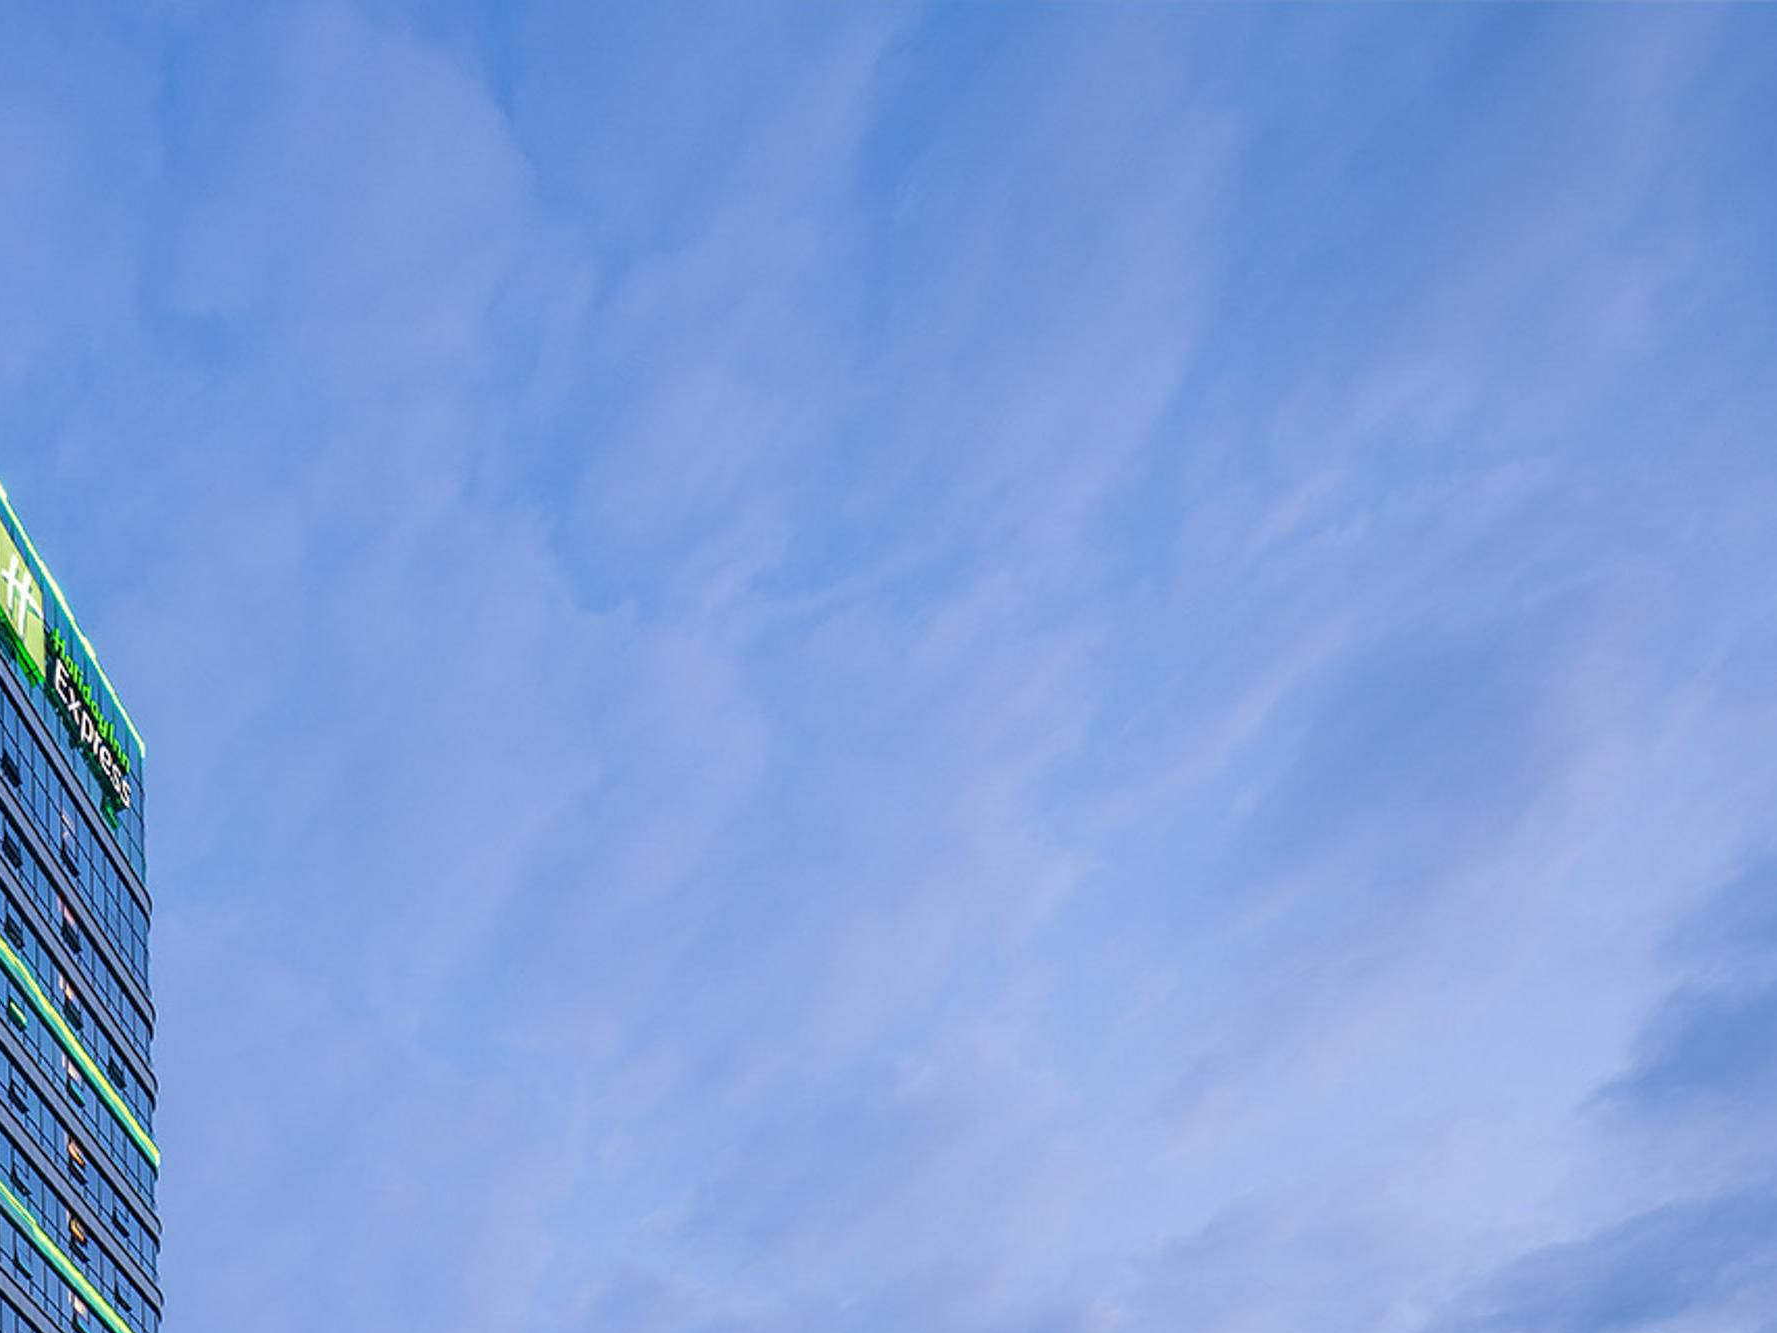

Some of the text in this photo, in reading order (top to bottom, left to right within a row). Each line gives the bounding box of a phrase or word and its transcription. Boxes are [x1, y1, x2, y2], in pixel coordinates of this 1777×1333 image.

[51, 628, 130, 773] Holiday Inn
[55, 658, 132, 808] Express
